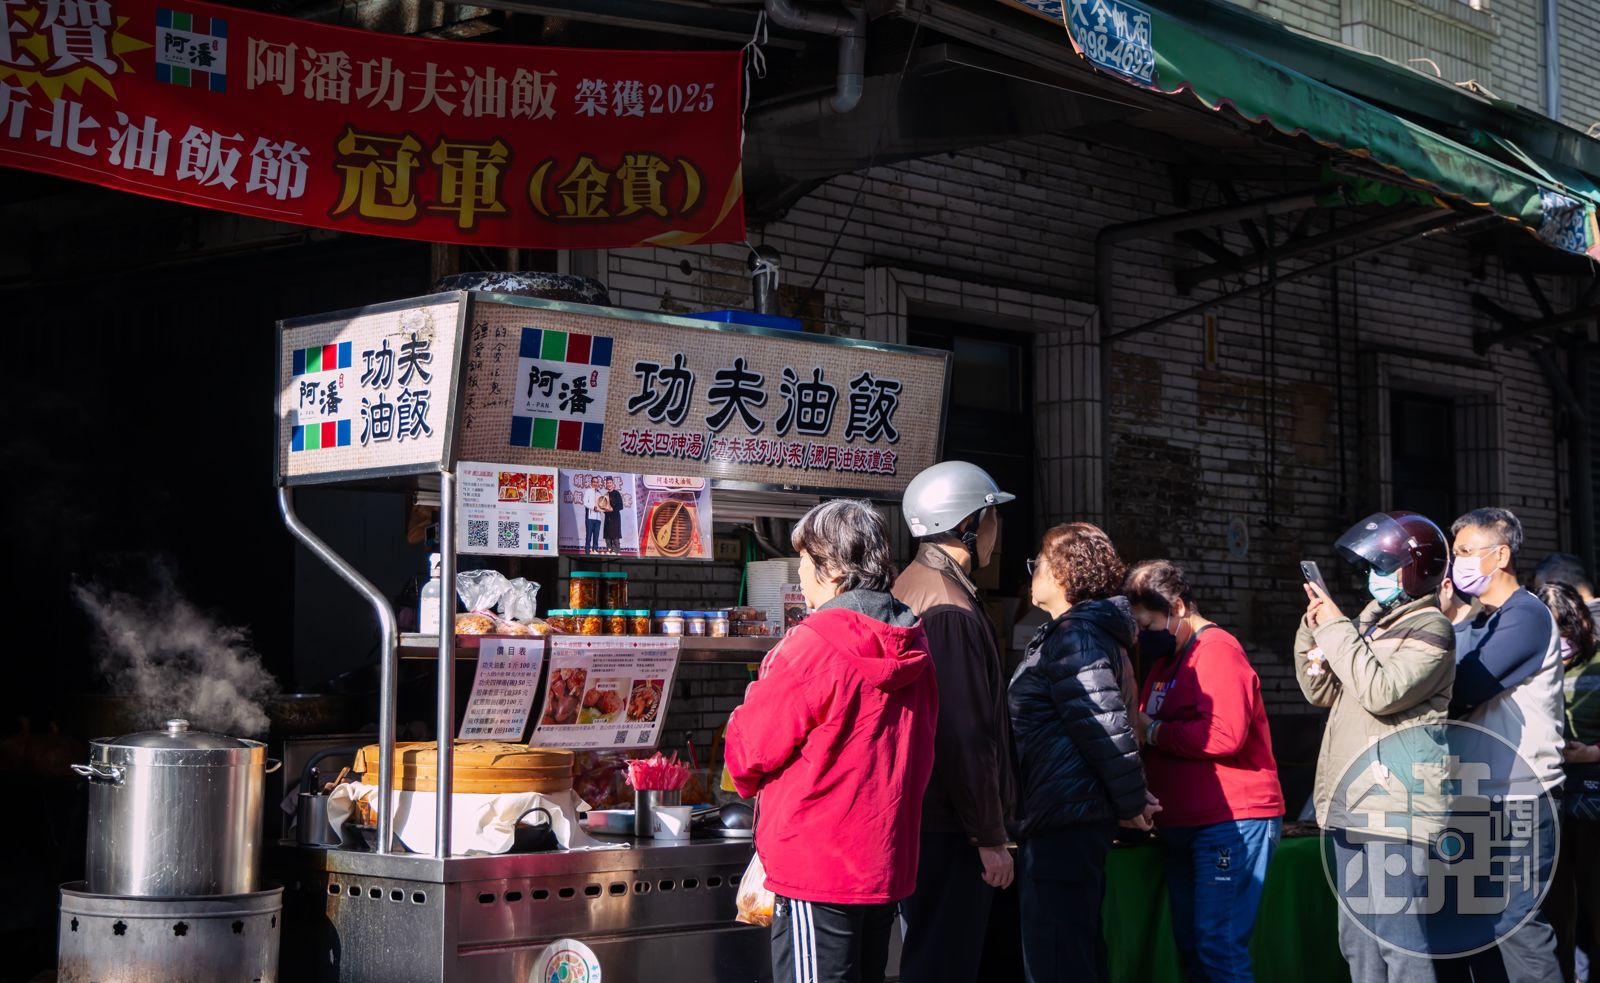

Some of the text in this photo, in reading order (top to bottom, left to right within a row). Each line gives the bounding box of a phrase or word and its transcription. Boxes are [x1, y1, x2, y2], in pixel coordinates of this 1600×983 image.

[164, 32, 217, 67] 阿潘
[246, 36, 716, 120] 阿潘功夫油飯 榮獲2025
[332, 127, 508, 229] 冠軍
[360, 332, 433, 390] 功夫
[527, 365, 595, 415] 阿潘
[299, 379, 343, 417] 阿潘
[360, 387, 433, 447] 油飯
[627, 352, 903, 443] 功夫油飯
